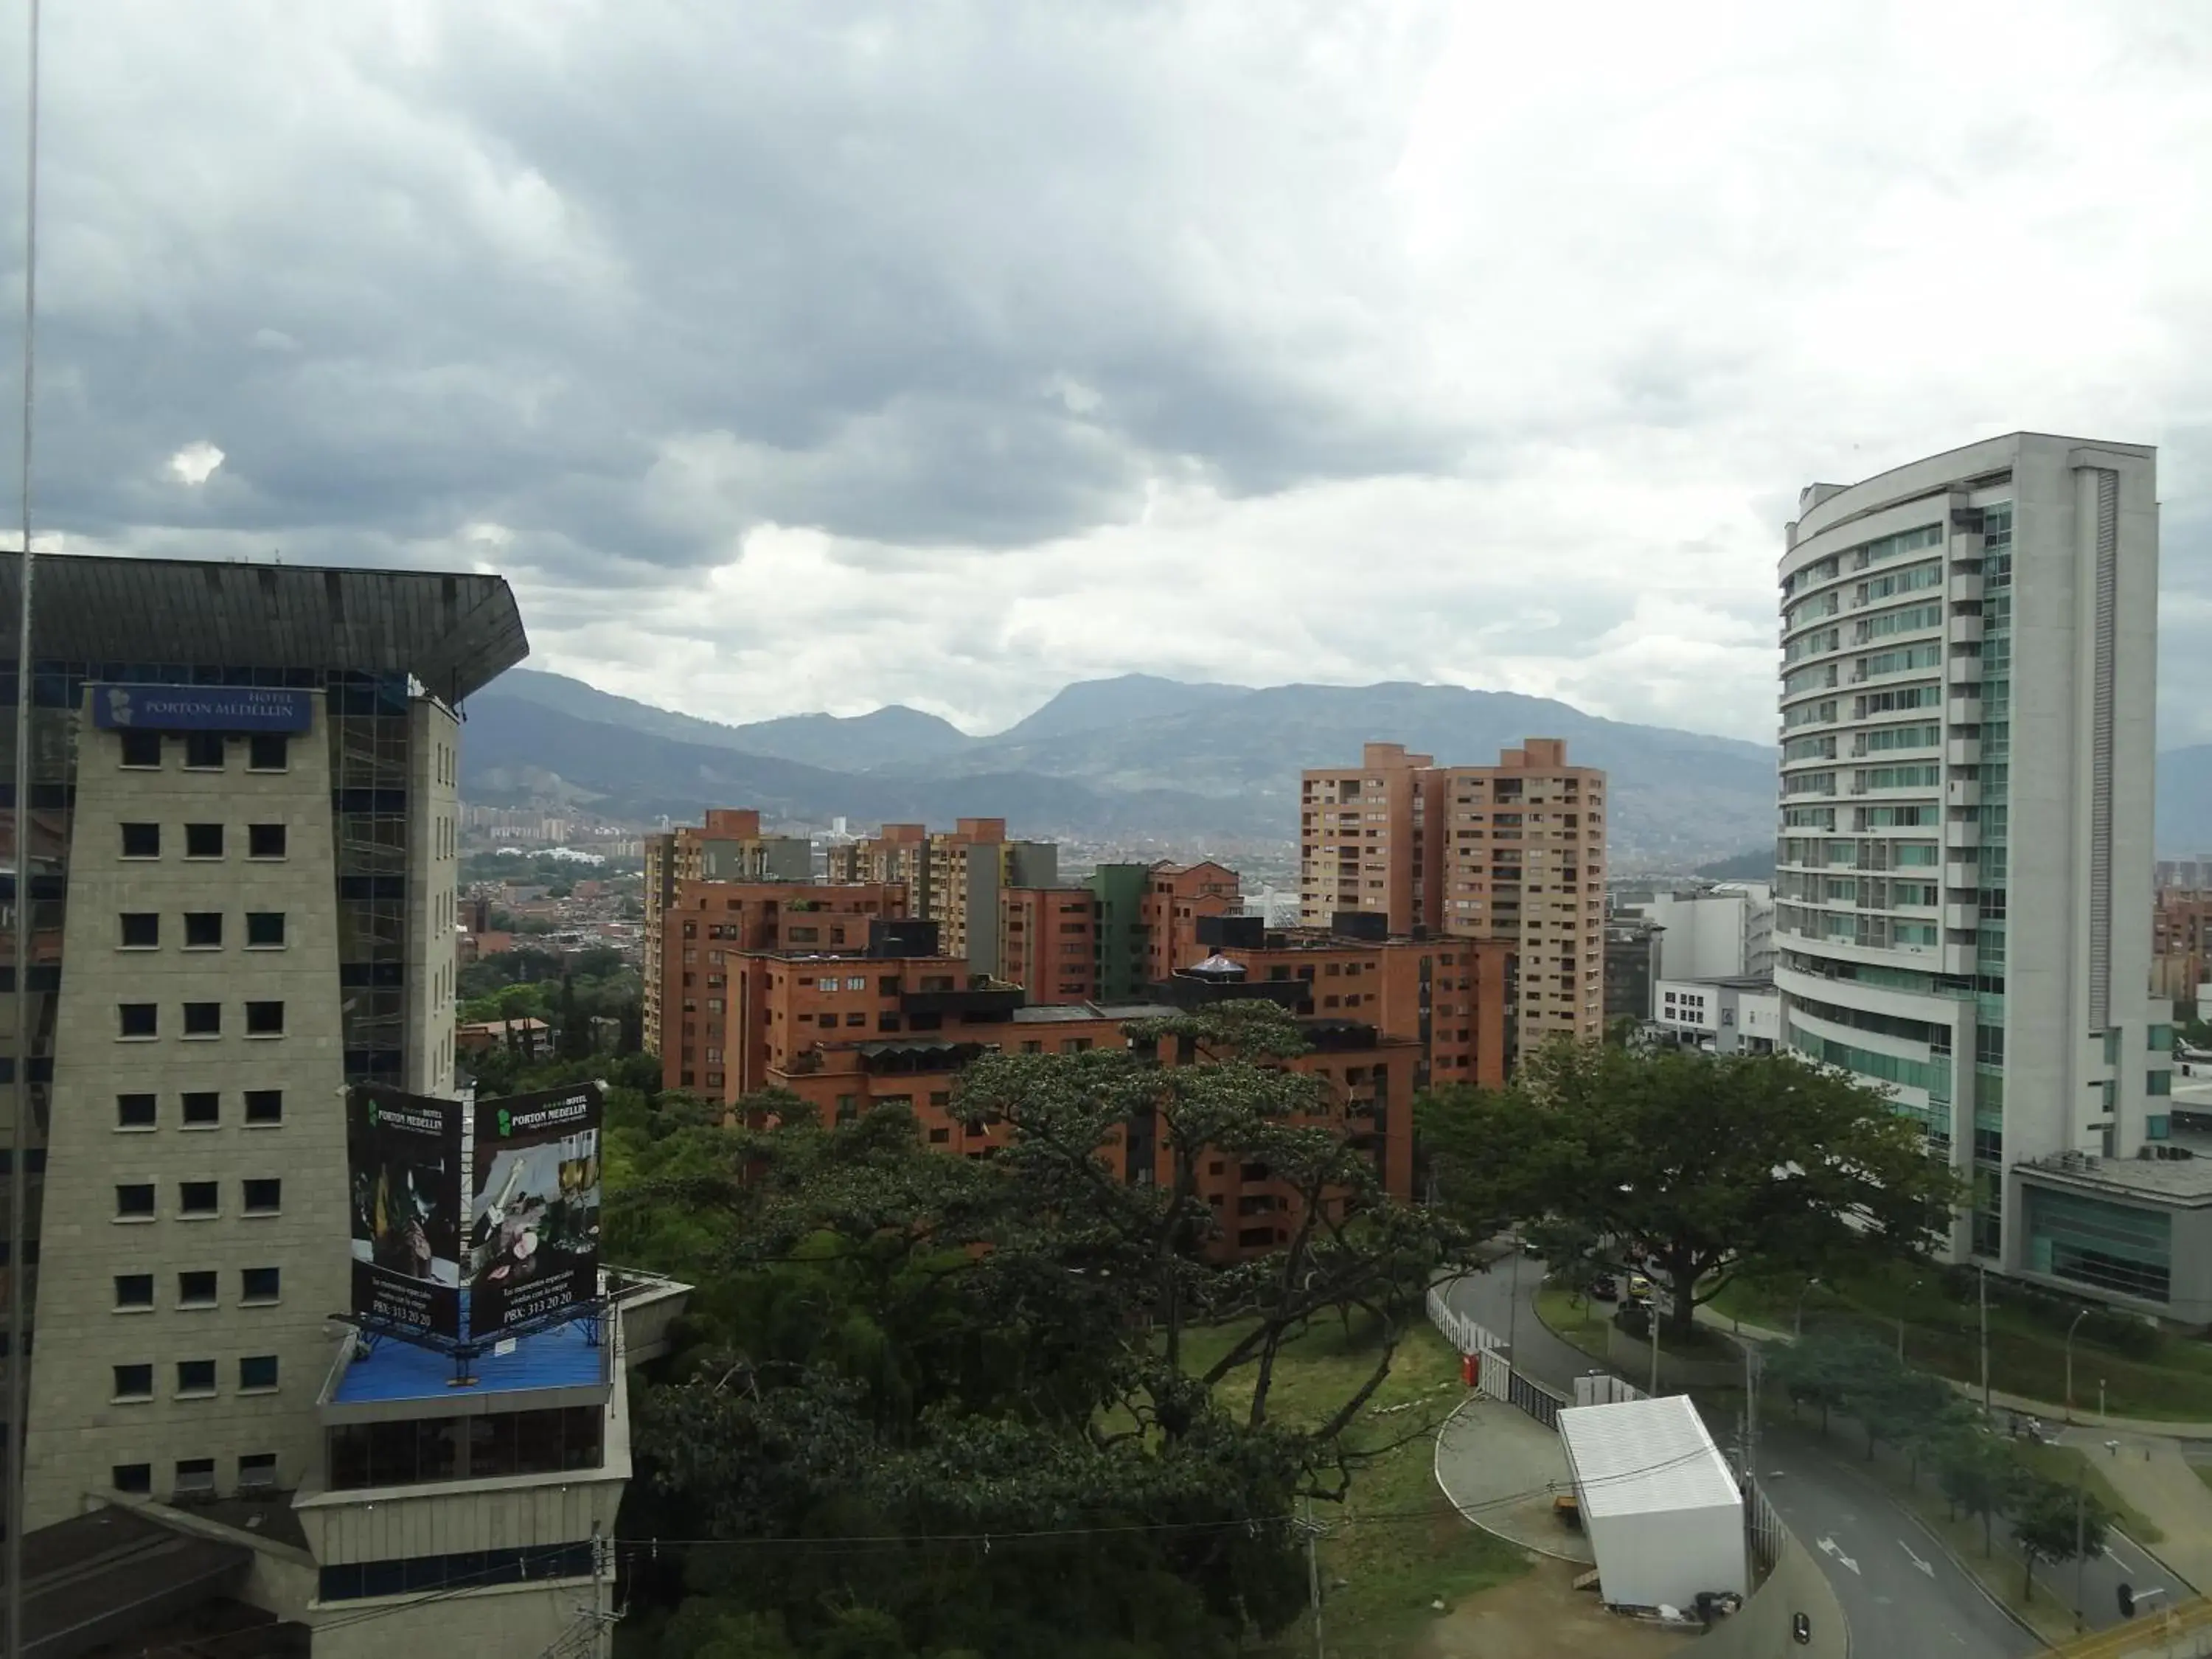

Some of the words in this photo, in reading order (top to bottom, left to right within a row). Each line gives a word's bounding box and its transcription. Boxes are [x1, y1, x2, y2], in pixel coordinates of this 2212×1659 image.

[249, 691, 293, 703] HOTEL
[145, 701, 211, 714] PORTON
[565, 1095, 588, 1105] HOTEL
[378, 1110, 406, 1123] PORTON
[406, 1115, 442, 1130] MEDELLIN
[512, 1111, 546, 1127] PORTON
[548, 1104, 587, 1120] MEDELLIN
[504, 1307, 526, 1324] PBX:
[528, 1300, 546, 1315] 313
[546, 1295, 559, 1310] 20
[560, 1291, 572, 1304] 20
